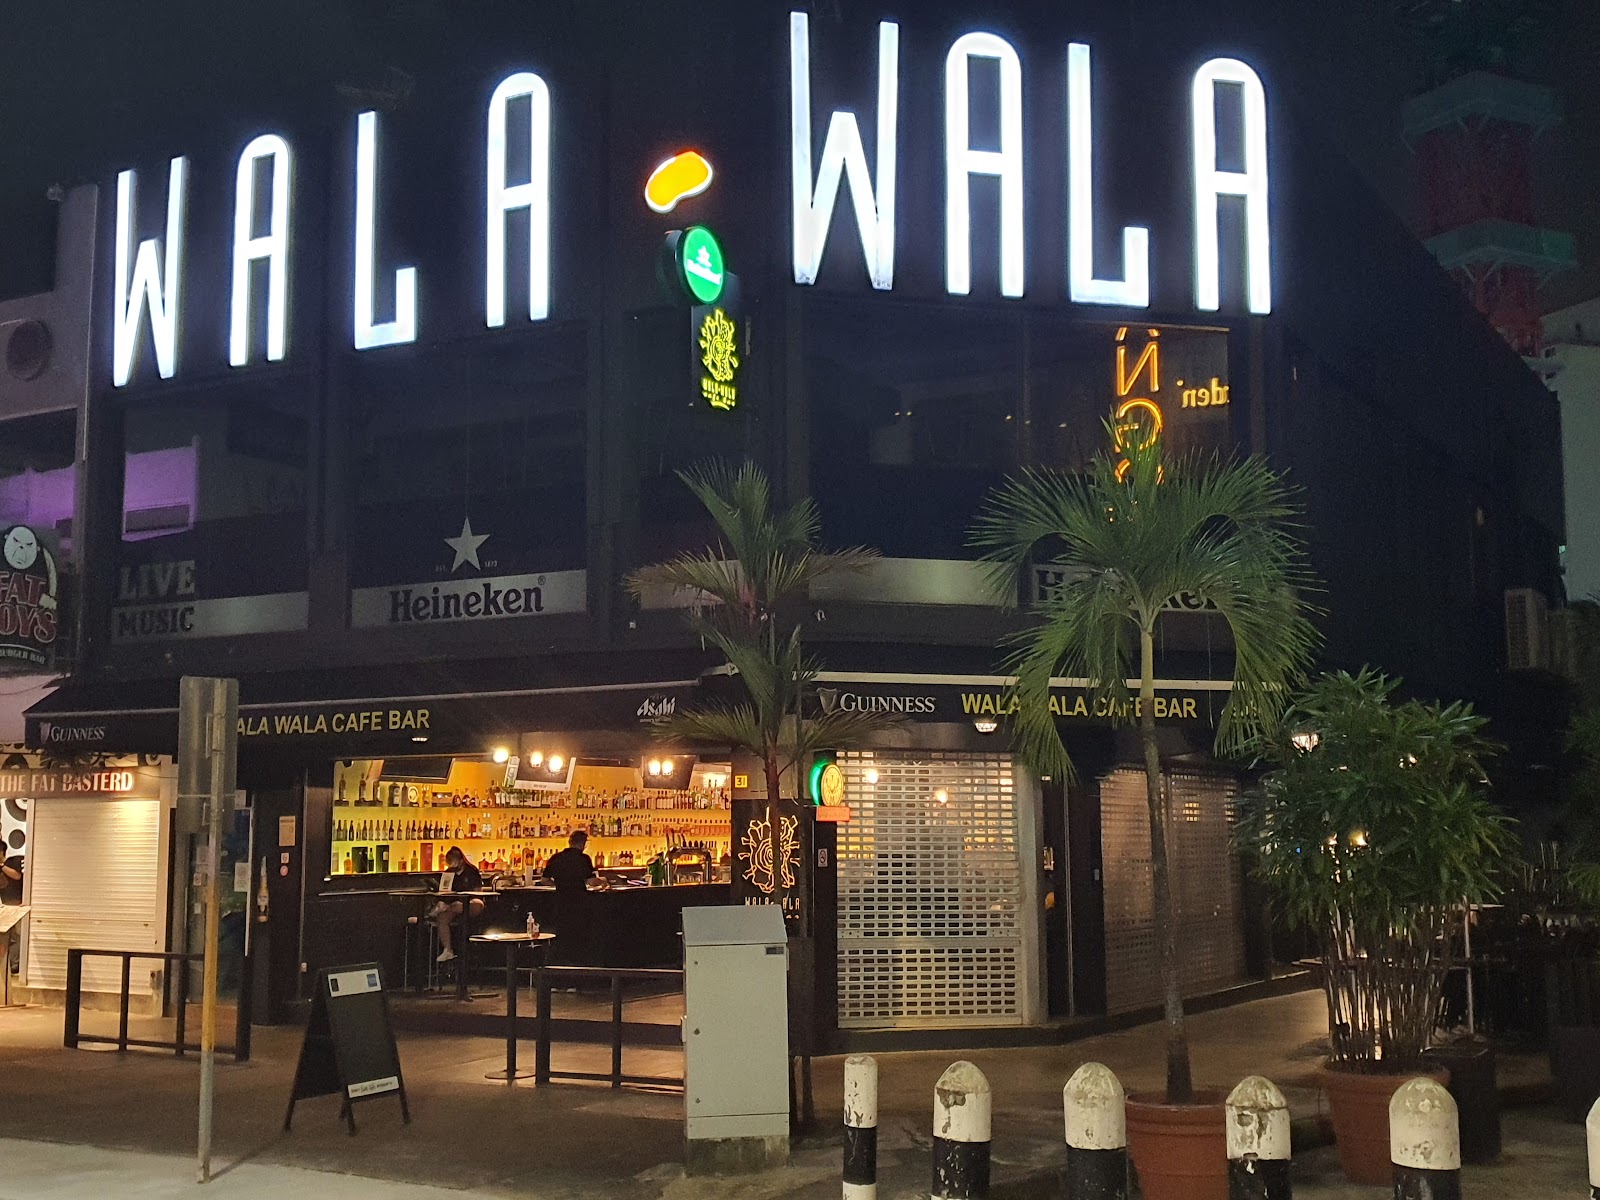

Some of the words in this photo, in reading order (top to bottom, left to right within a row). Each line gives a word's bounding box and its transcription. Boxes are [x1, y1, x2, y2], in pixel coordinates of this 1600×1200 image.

[112, 71, 552, 388] WALA
[789, 10, 1272, 316] WALA
[120, 560, 196, 598] LIVE
[390, 581, 544, 622] Heineken
[118, 605, 194, 636] MUSIC
[636, 696, 677, 717] Asahi
[840, 692, 936, 713] GUINNESS
[1048, 694, 1089, 717] ALA
[1154, 697, 1198, 719] BAR
[50, 725, 105, 743] GUINNESS
[237, 716, 269, 736] ALA
[275, 714, 328, 735] WALA
[332, 711, 384, 733] CAFE
[388, 709, 430, 731] BAR
[0, 774, 27, 792] THE
[62, 771, 134, 792] BASTERD
[736, 776, 746, 786] 31
[782, 897, 800, 911] ALA
